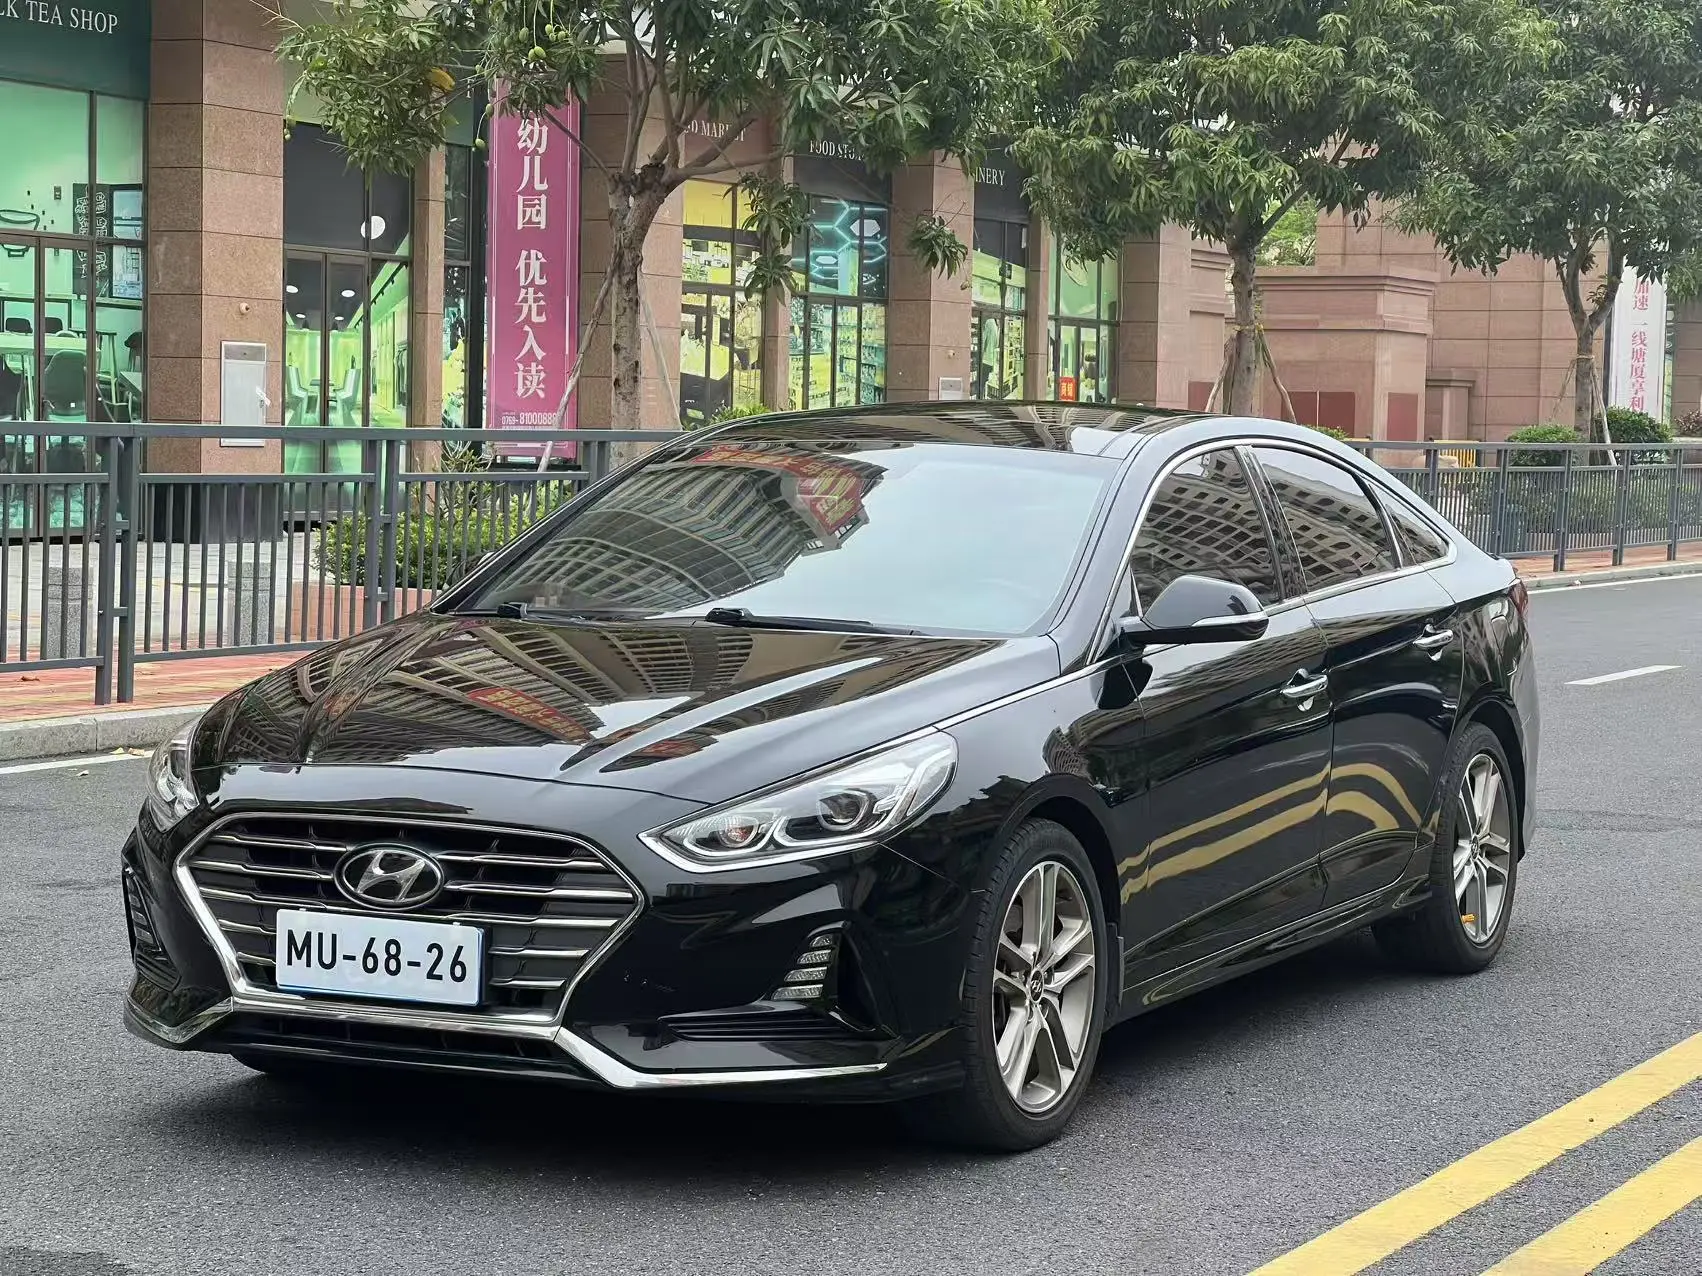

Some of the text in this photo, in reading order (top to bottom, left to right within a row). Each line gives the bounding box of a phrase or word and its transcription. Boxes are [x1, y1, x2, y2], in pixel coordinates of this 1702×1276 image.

[0, 0, 118, 34] K TEA SHOP
[701, 120, 746, 141] MART
[516, 118, 548, 230] 幼儿园
[515, 249, 547, 398] 优先入读
[286, 929, 467, 982] MU-68-26
